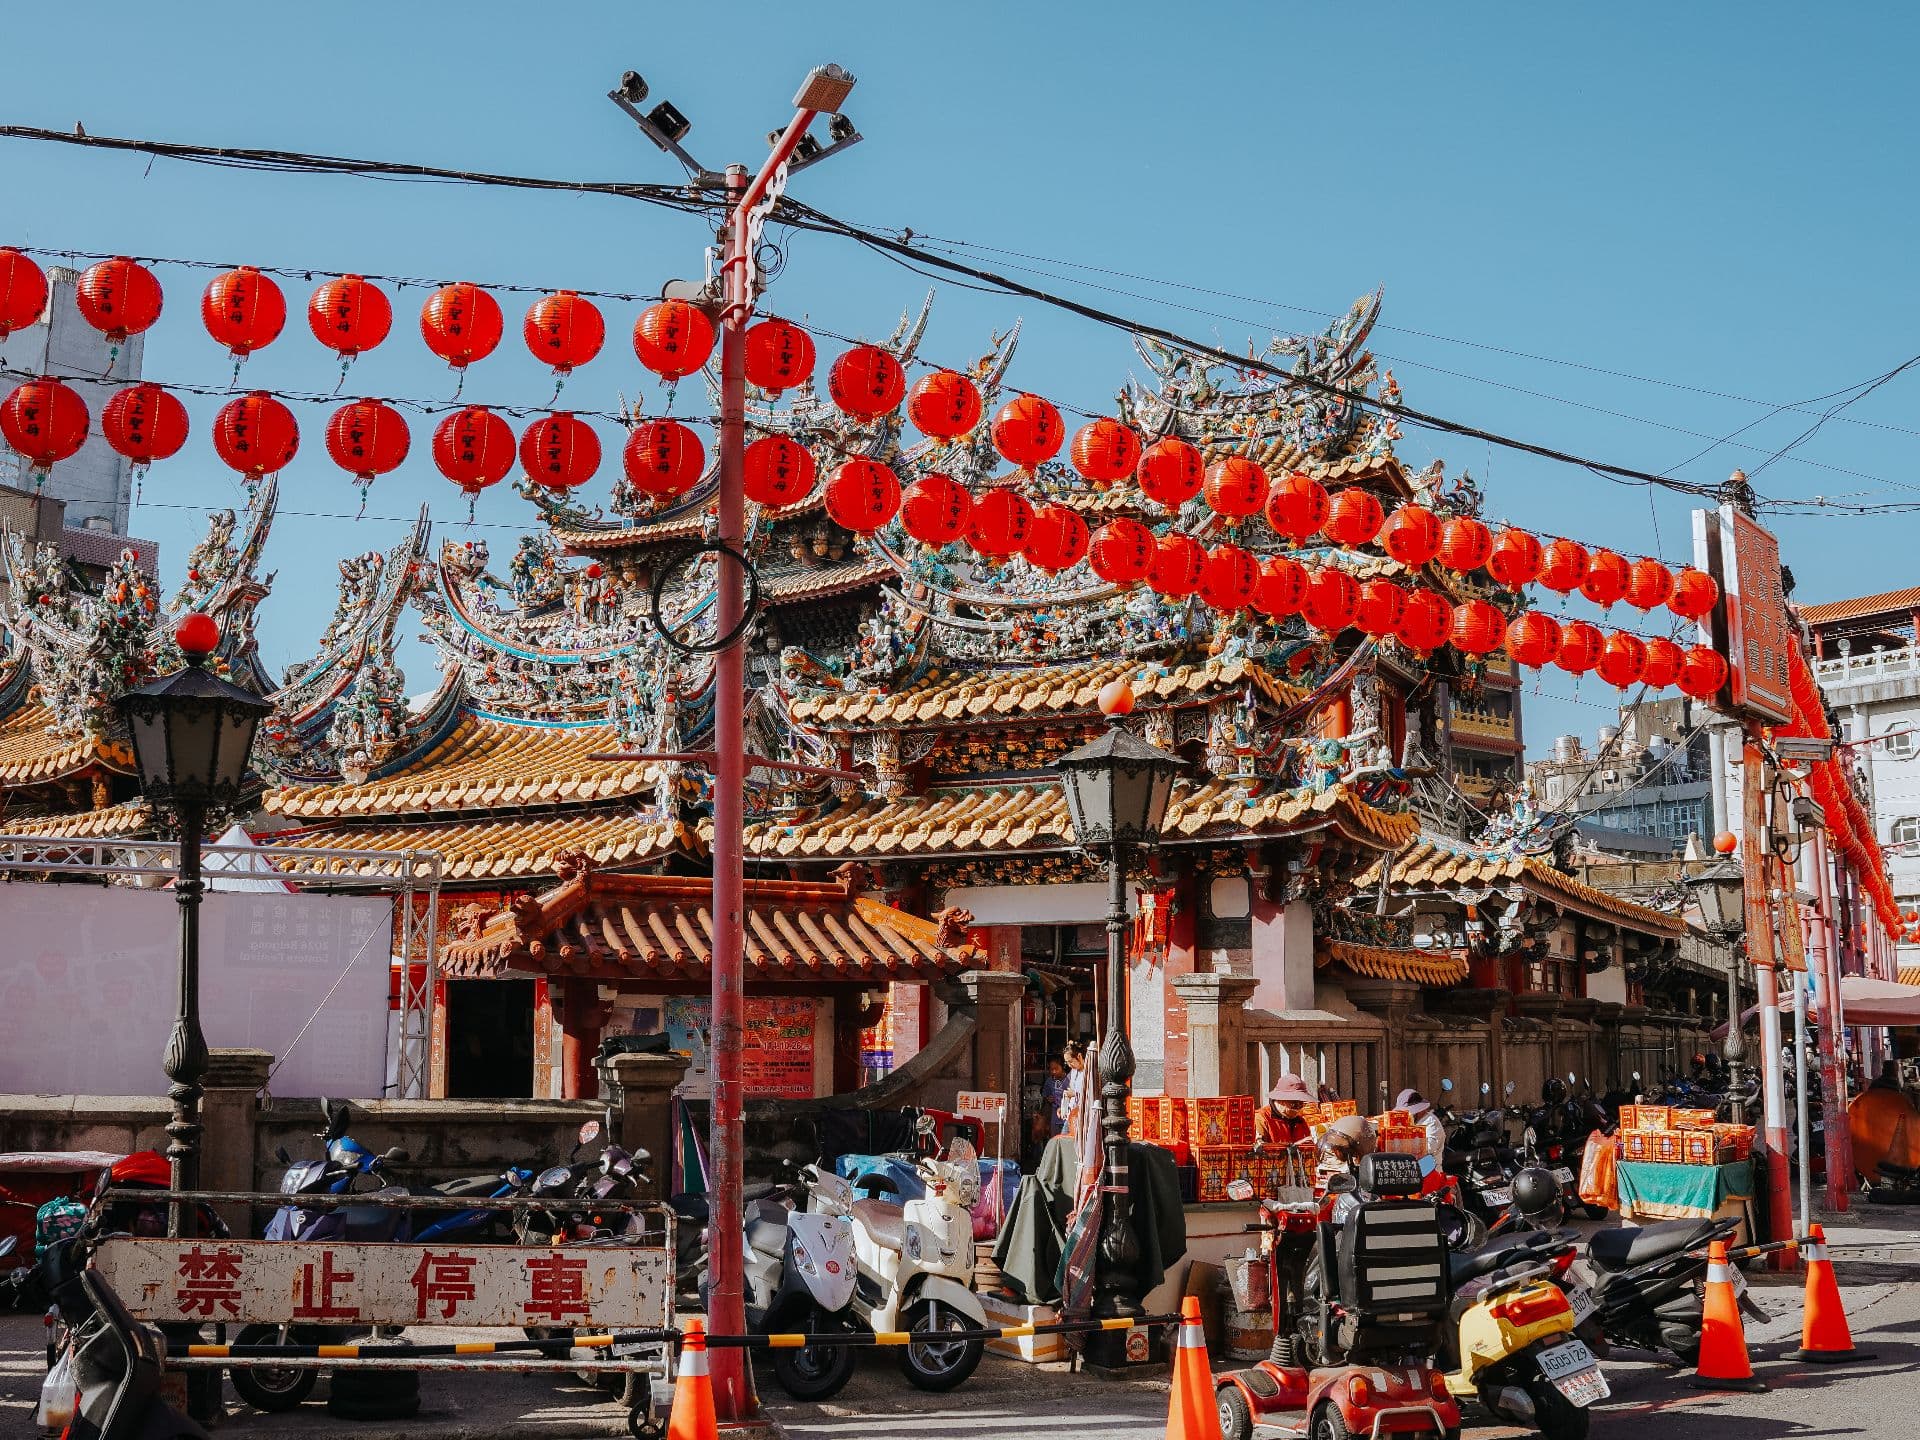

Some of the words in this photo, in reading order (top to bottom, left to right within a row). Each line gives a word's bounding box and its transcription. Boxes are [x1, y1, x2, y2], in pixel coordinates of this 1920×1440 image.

[230, 273, 244, 323] 天上聖母
[665, 305, 679, 353] 天上聖母
[778, 329, 793, 376] 天上聖母
[872, 350, 888, 397] 天上聖母
[130, 392, 145, 443] 天上聖母
[235, 400, 249, 452] 天上聖母
[462, 412, 475, 462] 天上聖母
[548, 424, 561, 473] 天上聖母
[657, 425, 670, 473] 天上聖母
[774, 444, 789, 491] 天上聖母
[868, 465, 882, 512] 天上聖母
[946, 485, 960, 529] 天上聖母
[1013, 497, 1026, 539] 天上聖母
[958, 1094, 1006, 1111] 禁止停車
[177, 1245, 592, 1322] 禁止停車
